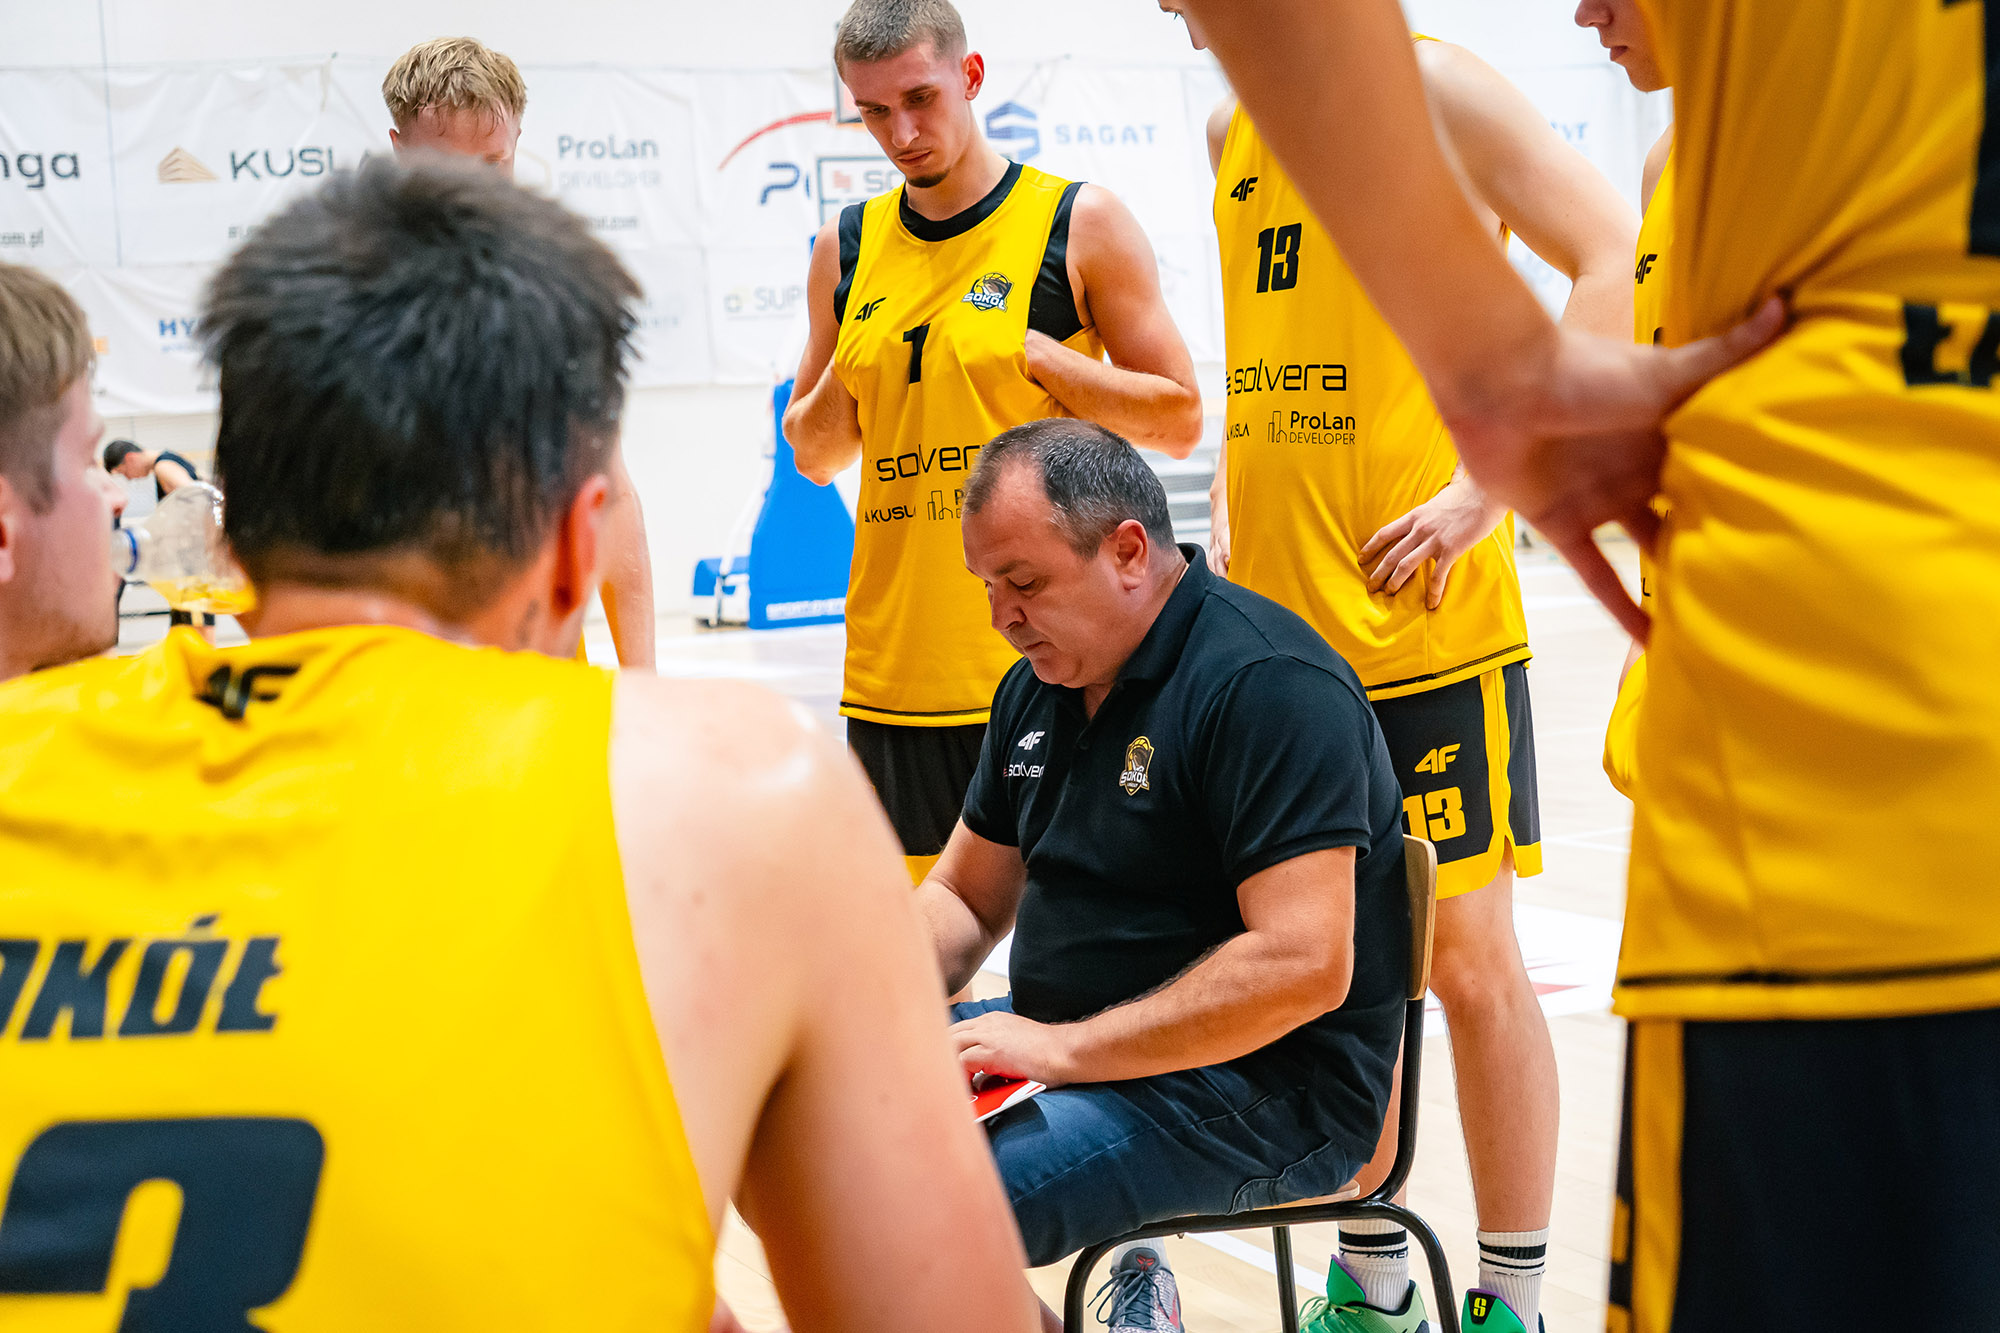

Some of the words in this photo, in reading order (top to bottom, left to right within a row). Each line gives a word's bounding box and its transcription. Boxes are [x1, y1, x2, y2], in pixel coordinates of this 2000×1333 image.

[557, 134, 660, 161] ProLan
[1055, 124, 1157, 145] SAGAT
[1230, 176, 1259, 202] 4F
[1256, 222, 1302, 294] 13
[1635, 253, 1659, 284] 4F
[853, 296, 887, 322] 4F
[902, 322, 931, 384] 1
[1234, 358, 1347, 395] solvera
[1290, 410, 1356, 430] ProLan
[1289, 431, 1356, 445] DEVELOPER
[1017, 731, 1046, 751] 4F
[1414, 743, 1461, 775] 4F
[1403, 786, 1466, 842] 13
